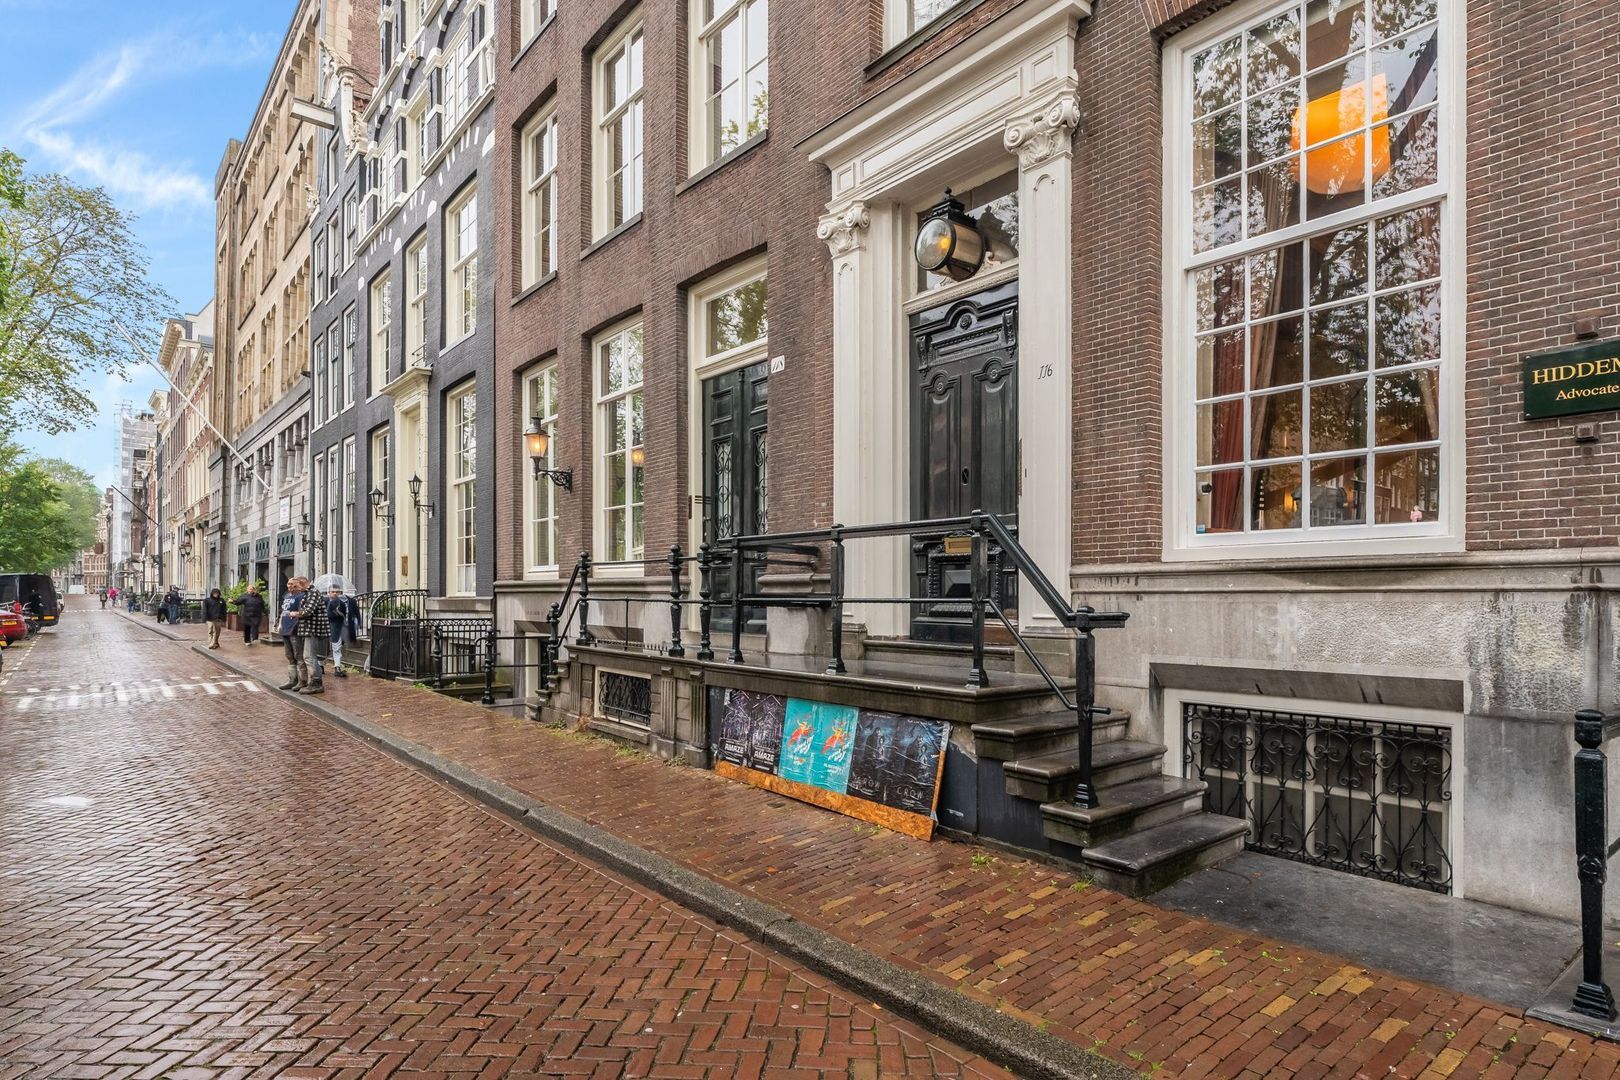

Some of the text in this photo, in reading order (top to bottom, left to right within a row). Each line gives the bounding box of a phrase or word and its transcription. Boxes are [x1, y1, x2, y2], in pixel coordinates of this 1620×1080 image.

[1037, 362, 1053, 380] 116
[724, 743, 744, 754] AMAZE
[753, 750, 775, 762] AMAZE
